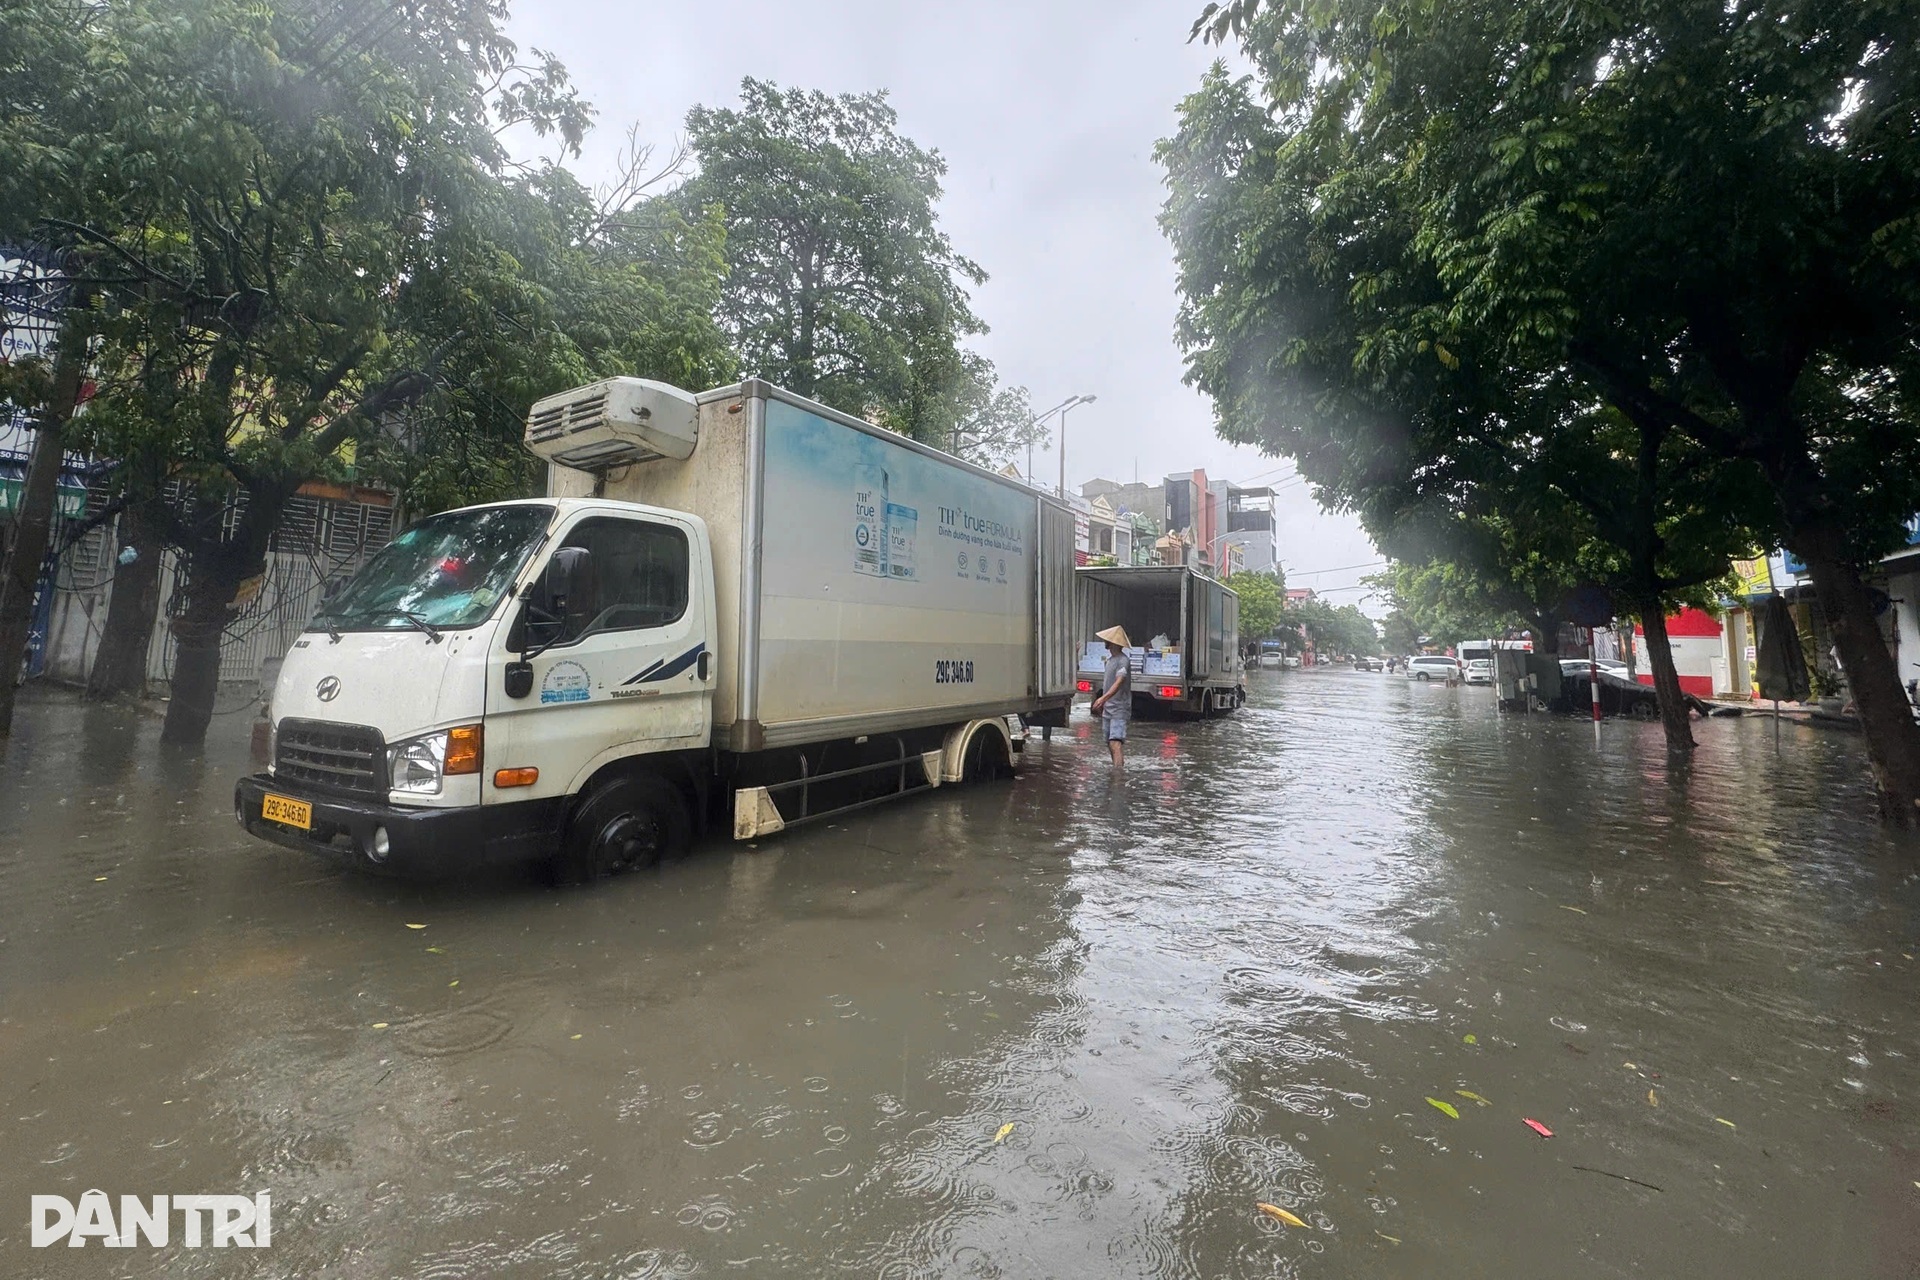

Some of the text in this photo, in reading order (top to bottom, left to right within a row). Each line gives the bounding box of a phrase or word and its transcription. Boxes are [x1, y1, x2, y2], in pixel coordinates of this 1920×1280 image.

[856, 502, 875, 518] true
[938, 506, 955, 526] TH
[936, 660, 974, 683] 29C 346.60
